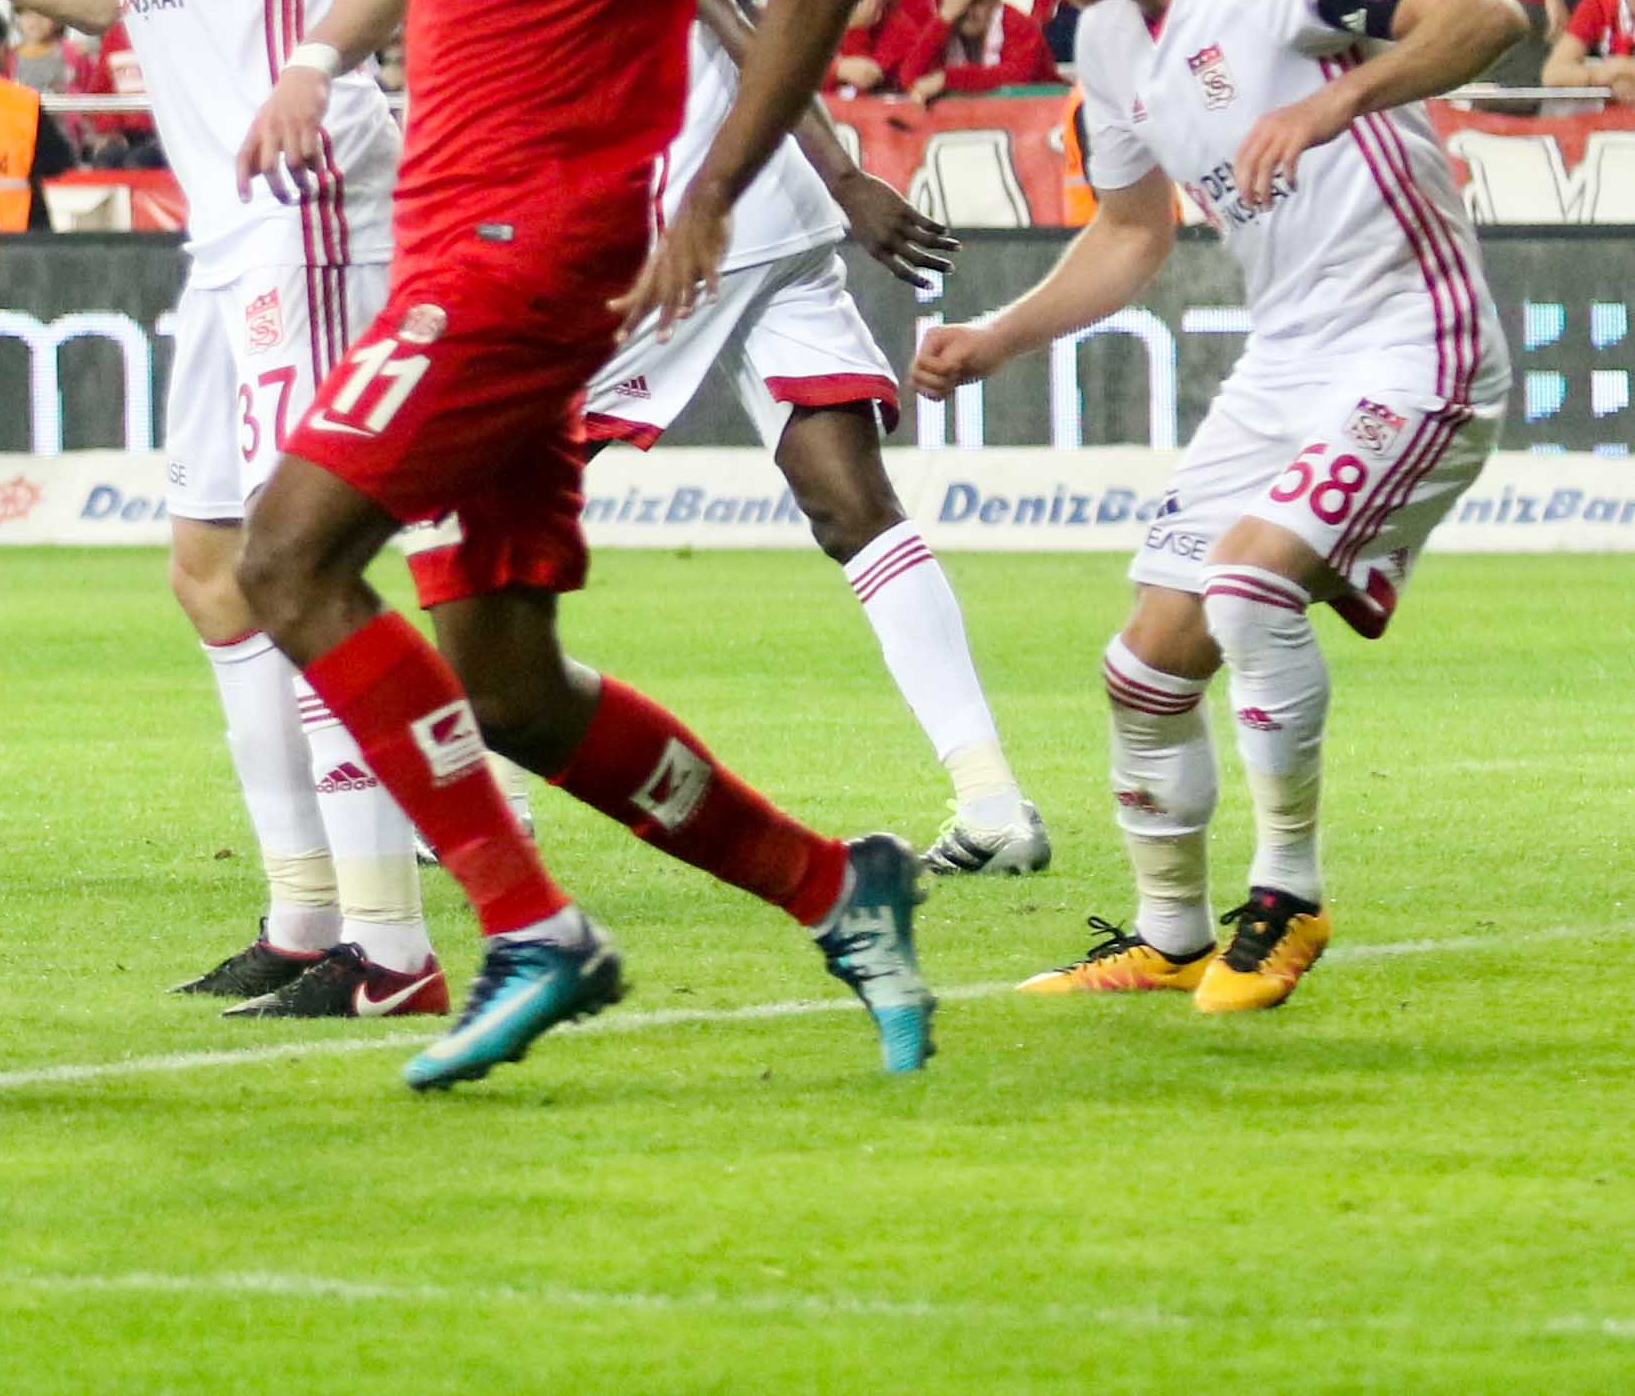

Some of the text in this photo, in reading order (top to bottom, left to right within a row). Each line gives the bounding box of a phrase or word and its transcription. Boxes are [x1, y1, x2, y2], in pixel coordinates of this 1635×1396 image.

[238, 364, 297, 464] 37
[330, 338, 432, 434] 11
[1269, 443, 1369, 526] 58
